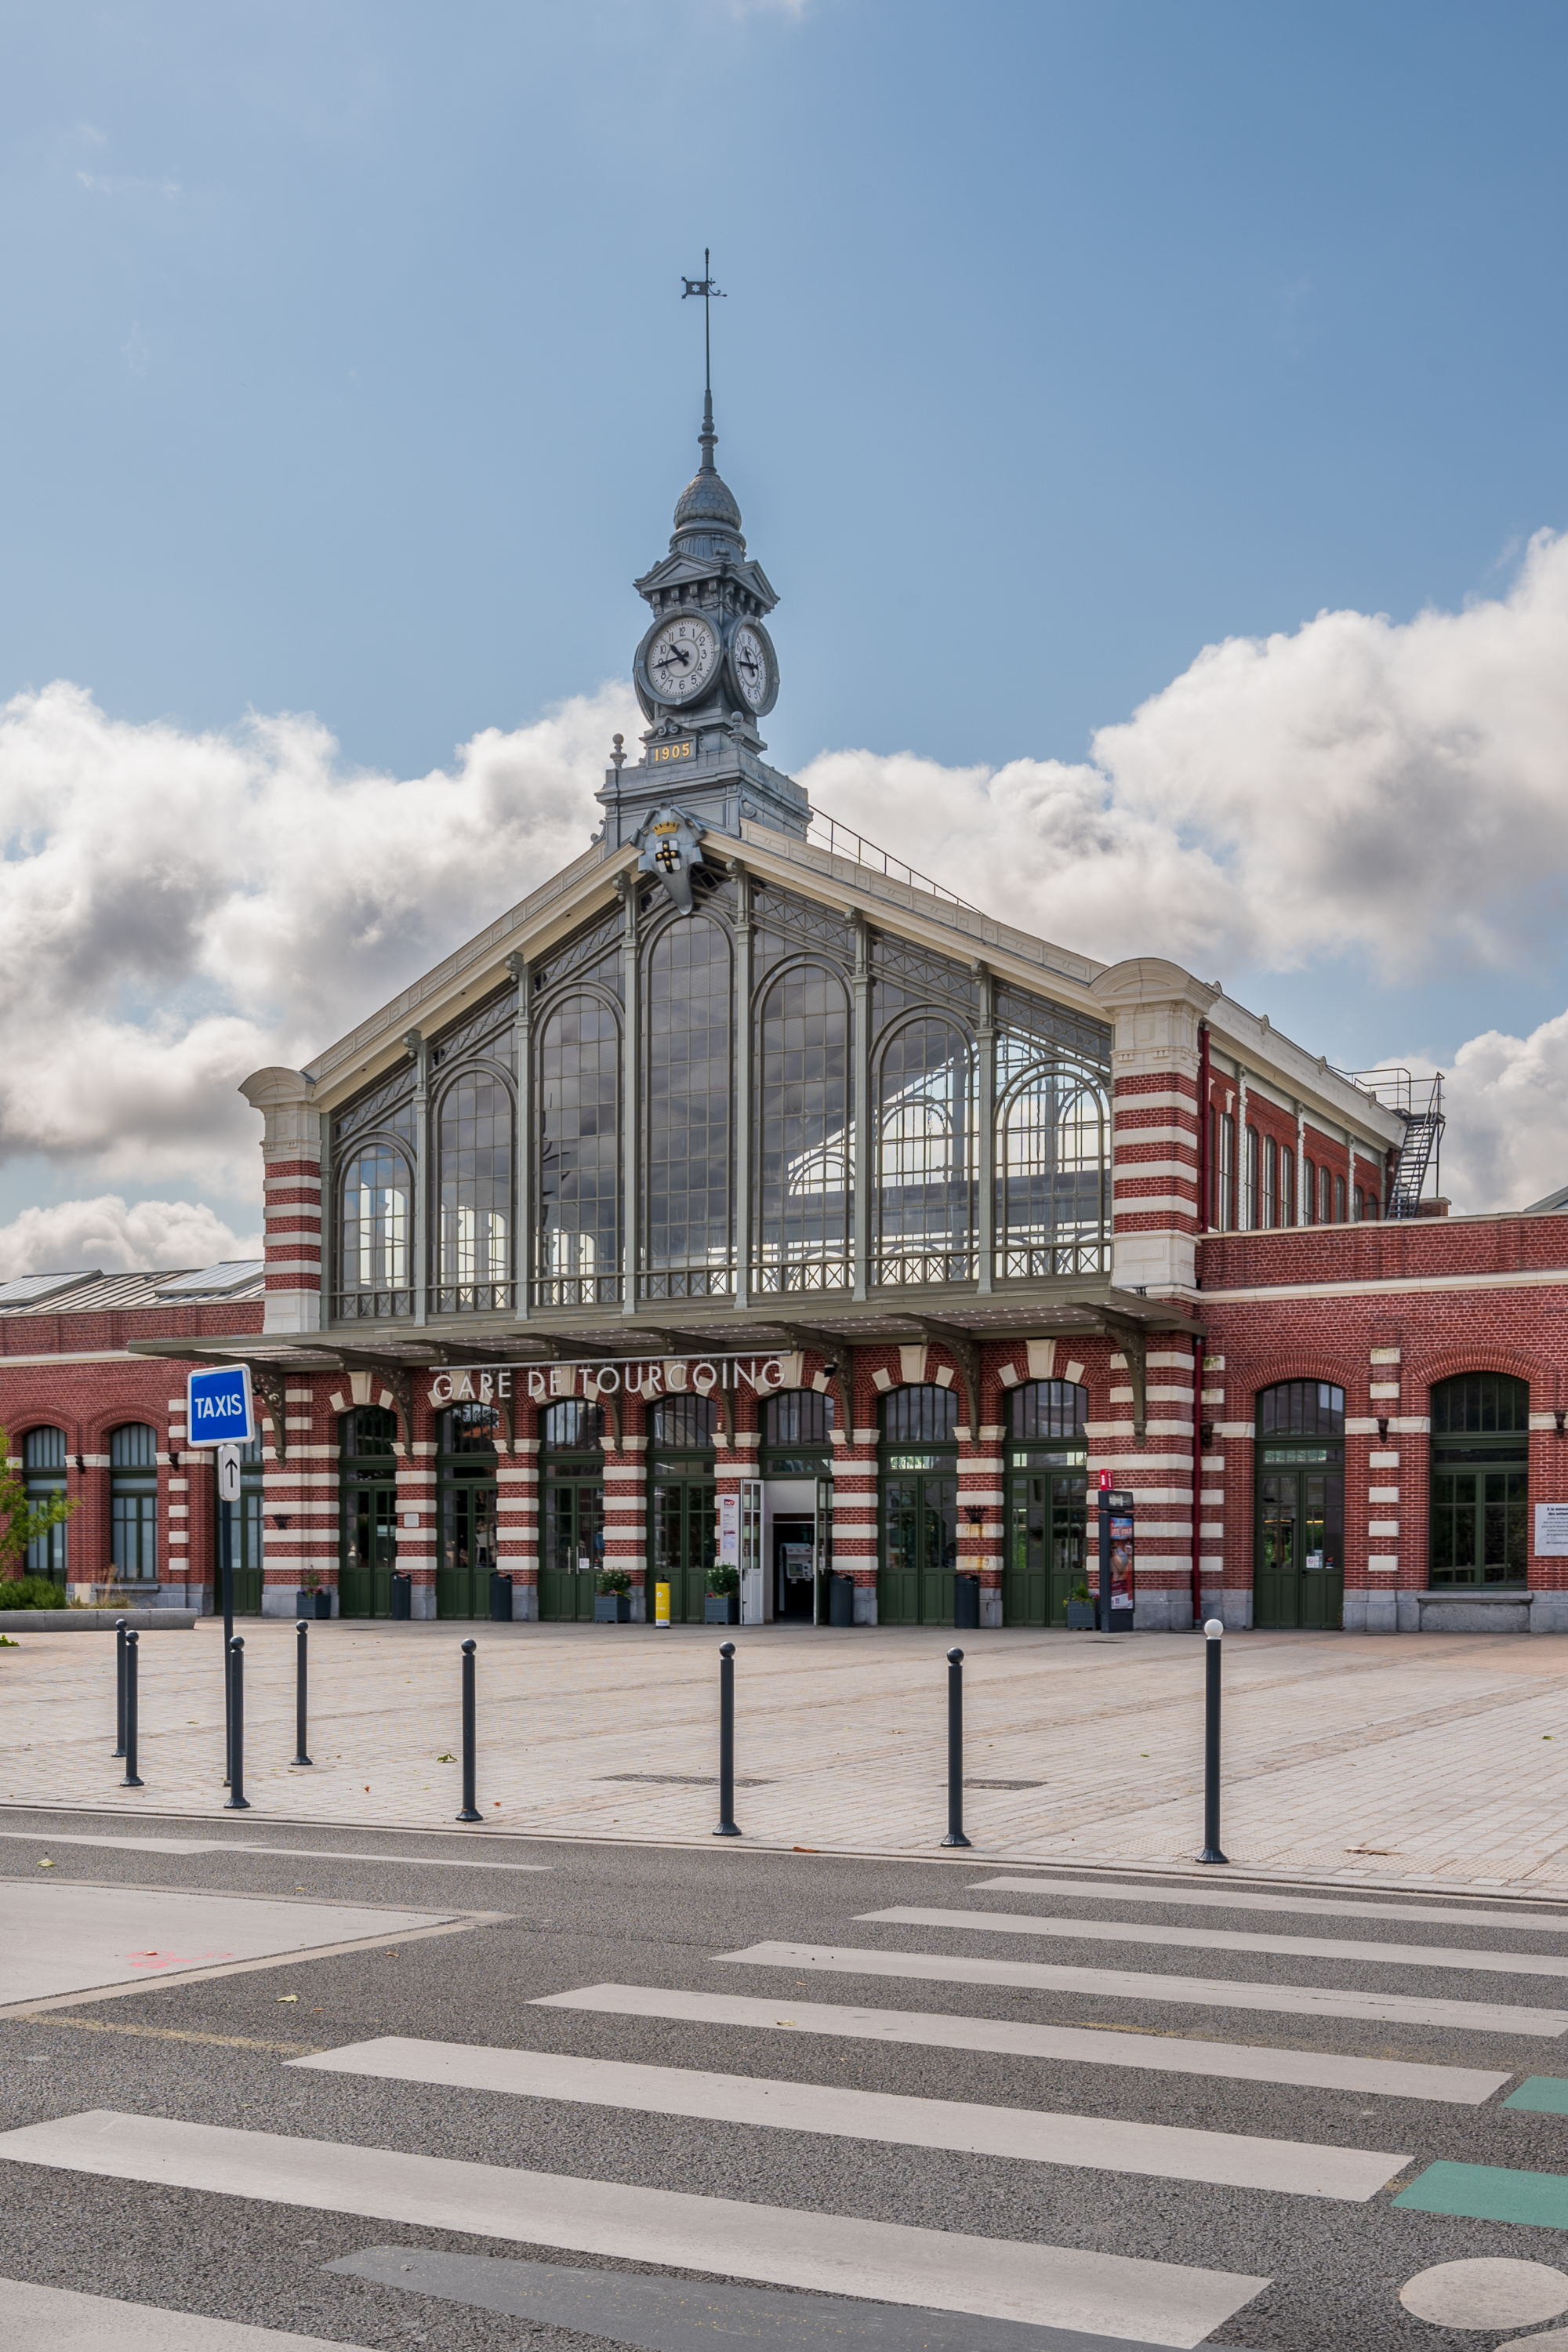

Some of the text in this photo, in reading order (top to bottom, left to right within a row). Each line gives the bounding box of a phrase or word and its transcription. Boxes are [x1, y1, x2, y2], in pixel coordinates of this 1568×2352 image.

[679, 626, 686, 637] 12
[692, 628, 695, 638] 1
[669, 632, 673, 642] 11
[699, 636, 706, 646] 2
[660, 644, 666, 655] 10
[701, 649, 707, 659] 3
[758, 656, 762, 666] 2
[697, 662, 702, 671] 4
[661, 670, 666, 679] 8
[691, 674, 697, 684] 5
[759, 670, 763, 680] 3
[668, 679, 673, 689] 7
[679, 680, 685, 689] 6
[747, 688, 751, 699] 6
[753, 689, 757, 699] 5
[655, 742, 690, 762] 1905
[433, 1360, 785, 1400] GARE DE TOURCOING
[194, 1394, 242, 1419] TAXIS
